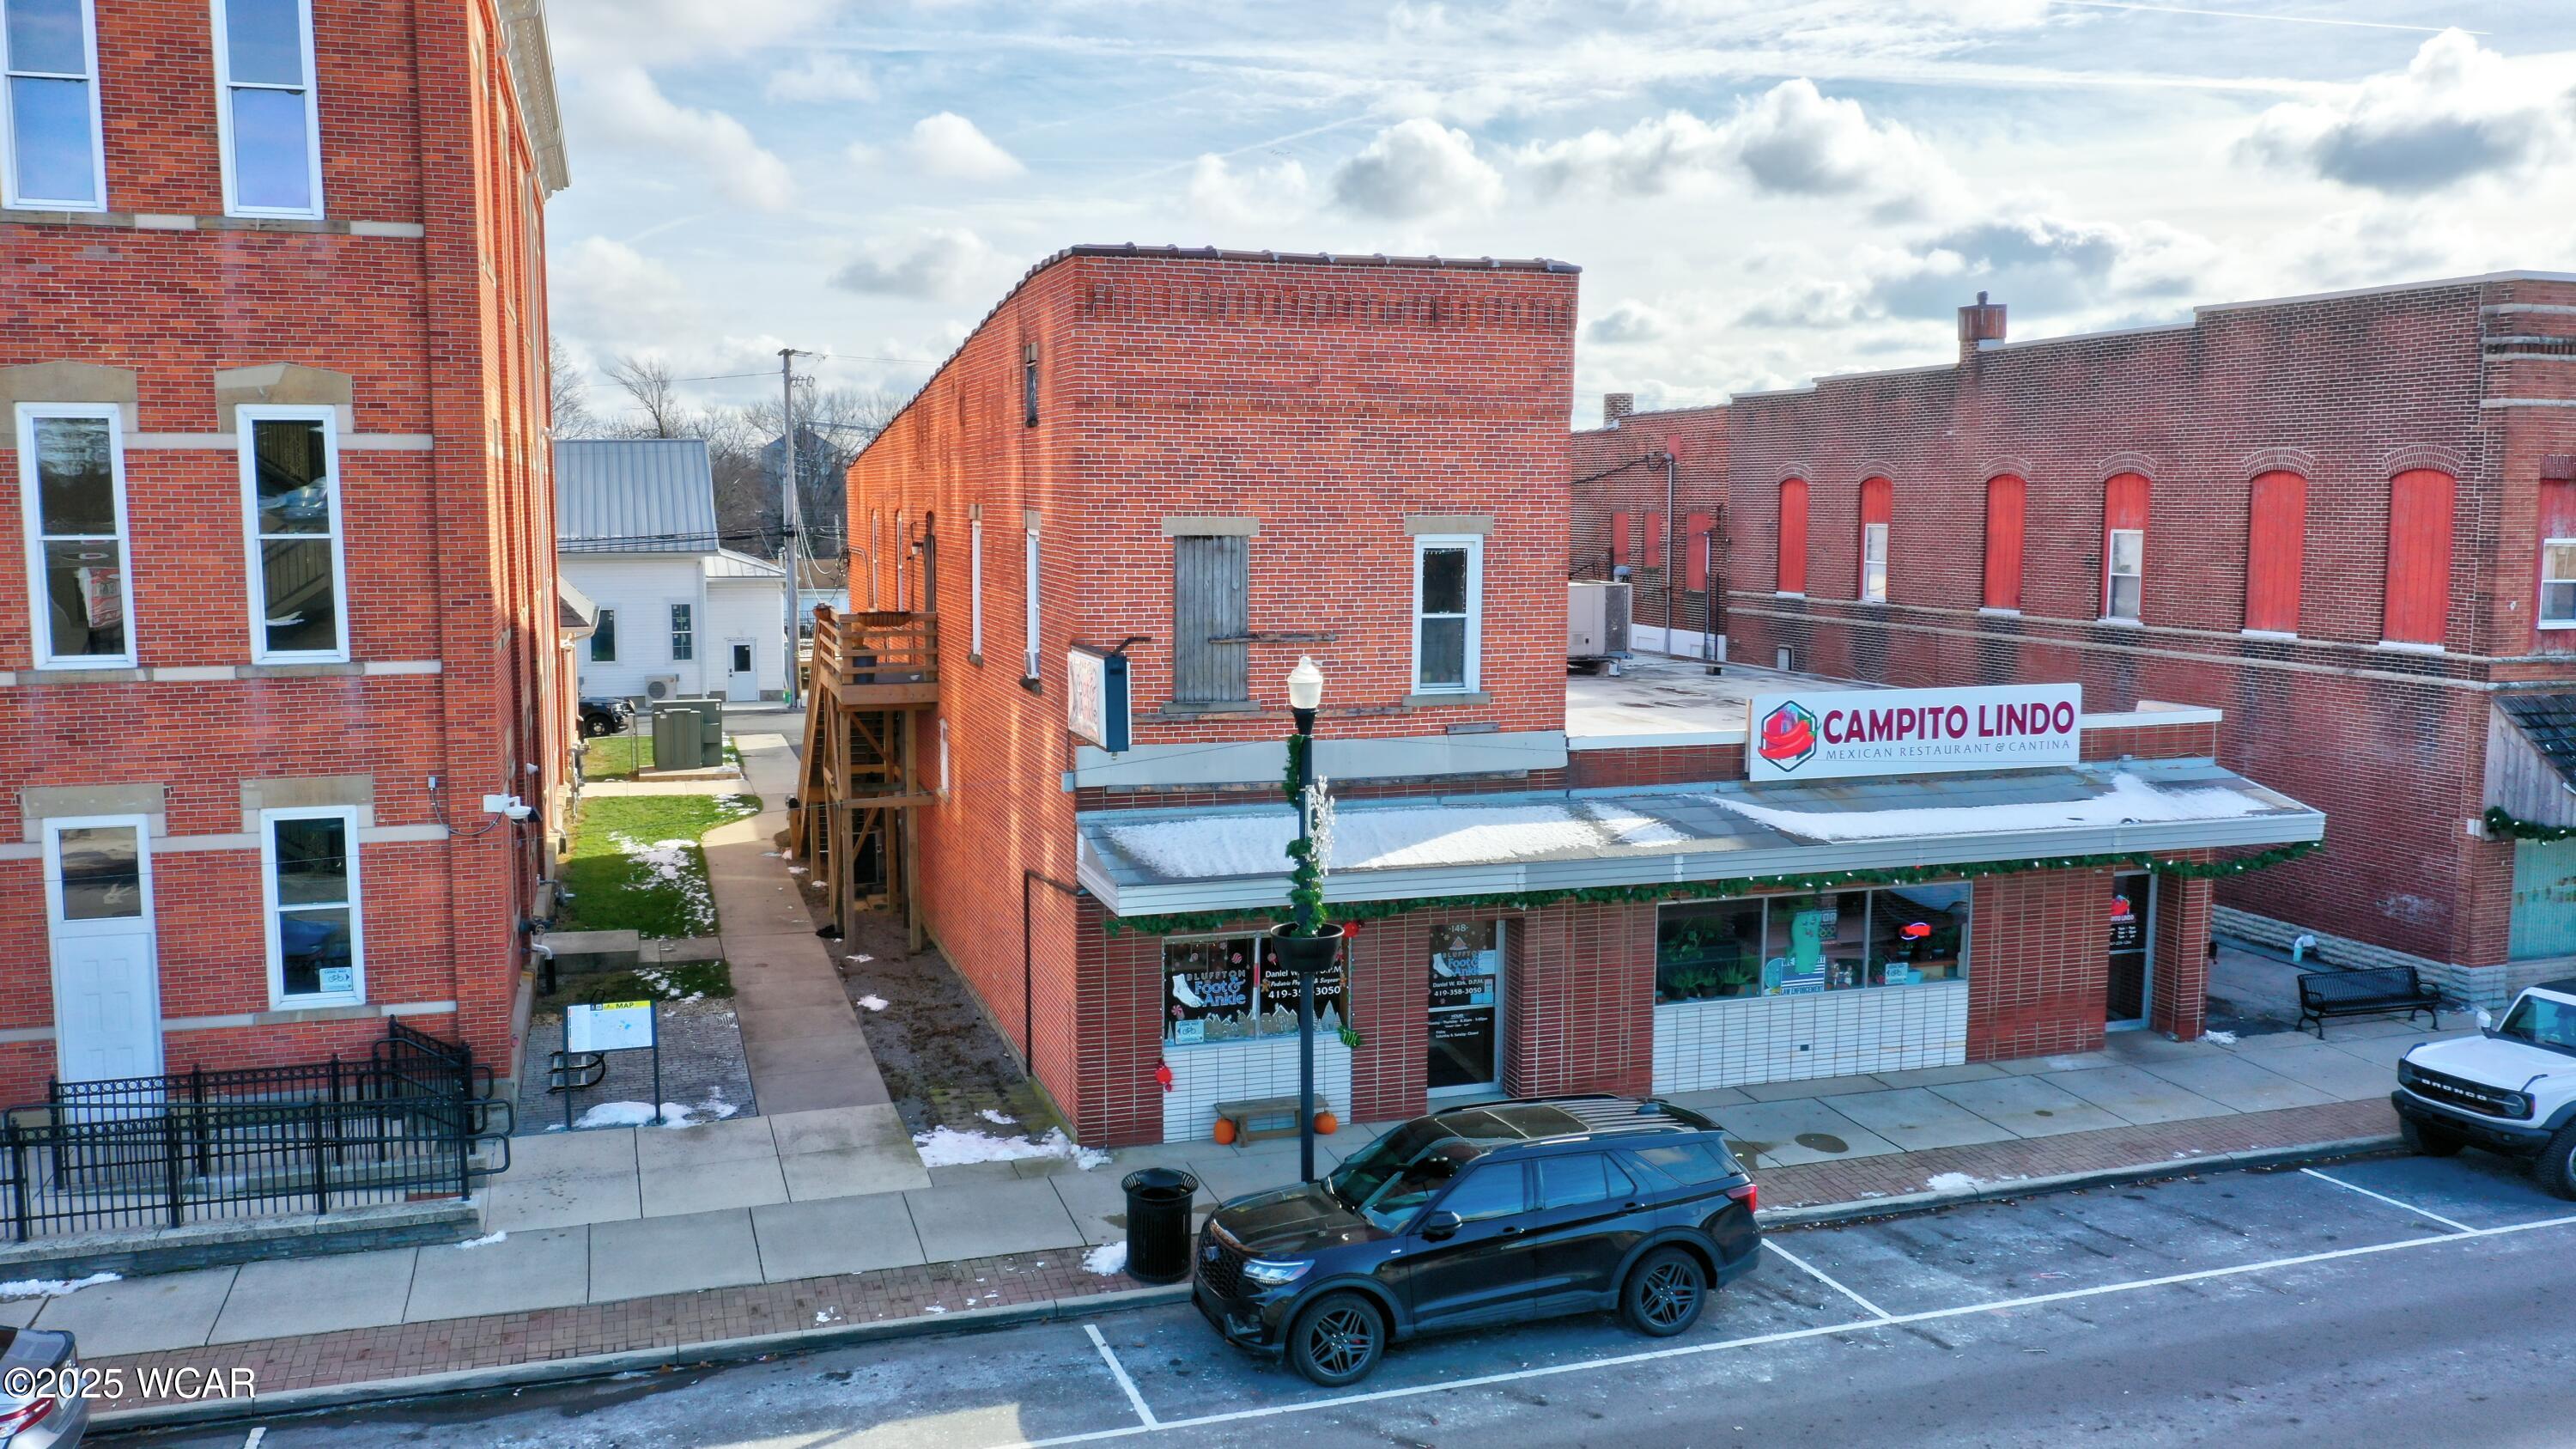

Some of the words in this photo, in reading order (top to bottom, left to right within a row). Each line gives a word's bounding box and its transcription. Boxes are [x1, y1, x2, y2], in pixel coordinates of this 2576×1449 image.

[1823, 704, 1968, 744] CAMPITO
[1978, 701, 2075, 737] LINDO
[1826, 748, 1893, 760] MEXICAN
[1900, 743, 1990, 757] RESTAURANT
[1996, 742, 2004, 752] &
[2008, 740, 2069, 752] CANTINA
[1448, 958, 1470, 968] Foot
[1187, 969, 1246, 981] BLUFFTON
[1265, 970, 1288, 978] Daniel
[1455, 965, 1483, 976] Ankle
[1194, 980, 1228, 995] Foot
[1434, 987, 1482, 996] 419-358-3050
[1202, 992, 1246, 1008] Ankle
[2421, 1078, 2488, 1101] BRONCO
